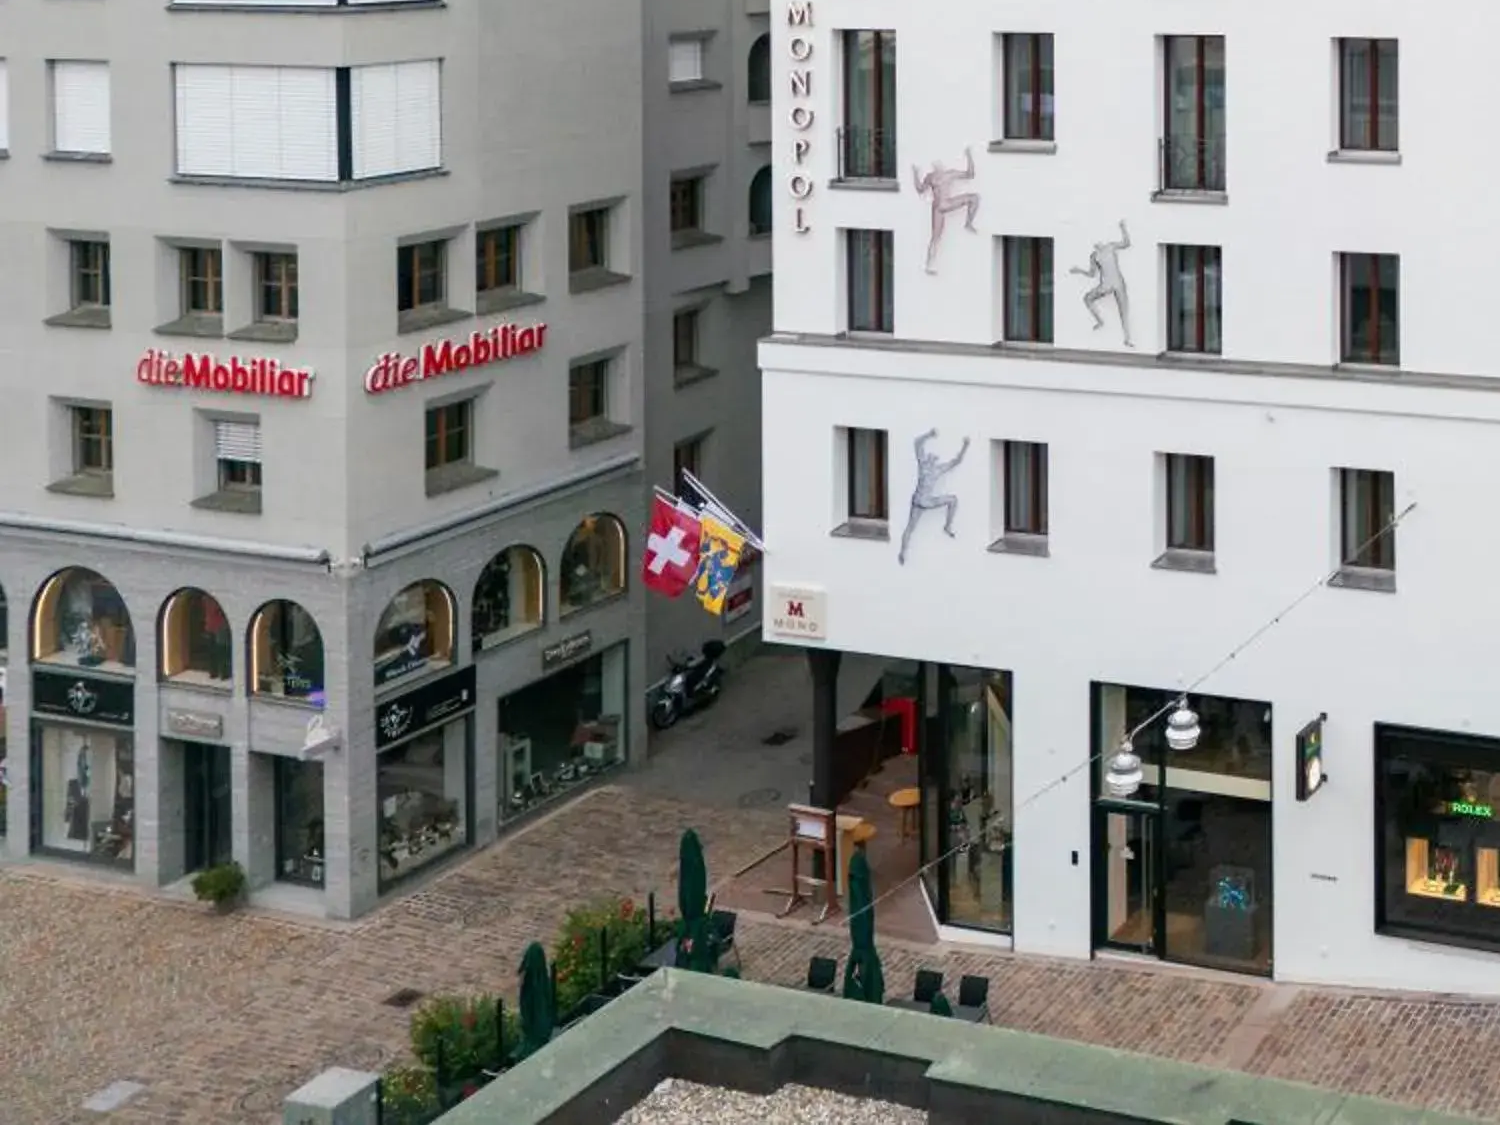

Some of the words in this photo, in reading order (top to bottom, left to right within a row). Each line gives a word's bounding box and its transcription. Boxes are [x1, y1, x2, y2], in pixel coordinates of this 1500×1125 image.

[787, 1, 814, 233] MONOPOL
[787, 600, 805, 618] M
[1452, 802, 1492, 817] ROLEX
